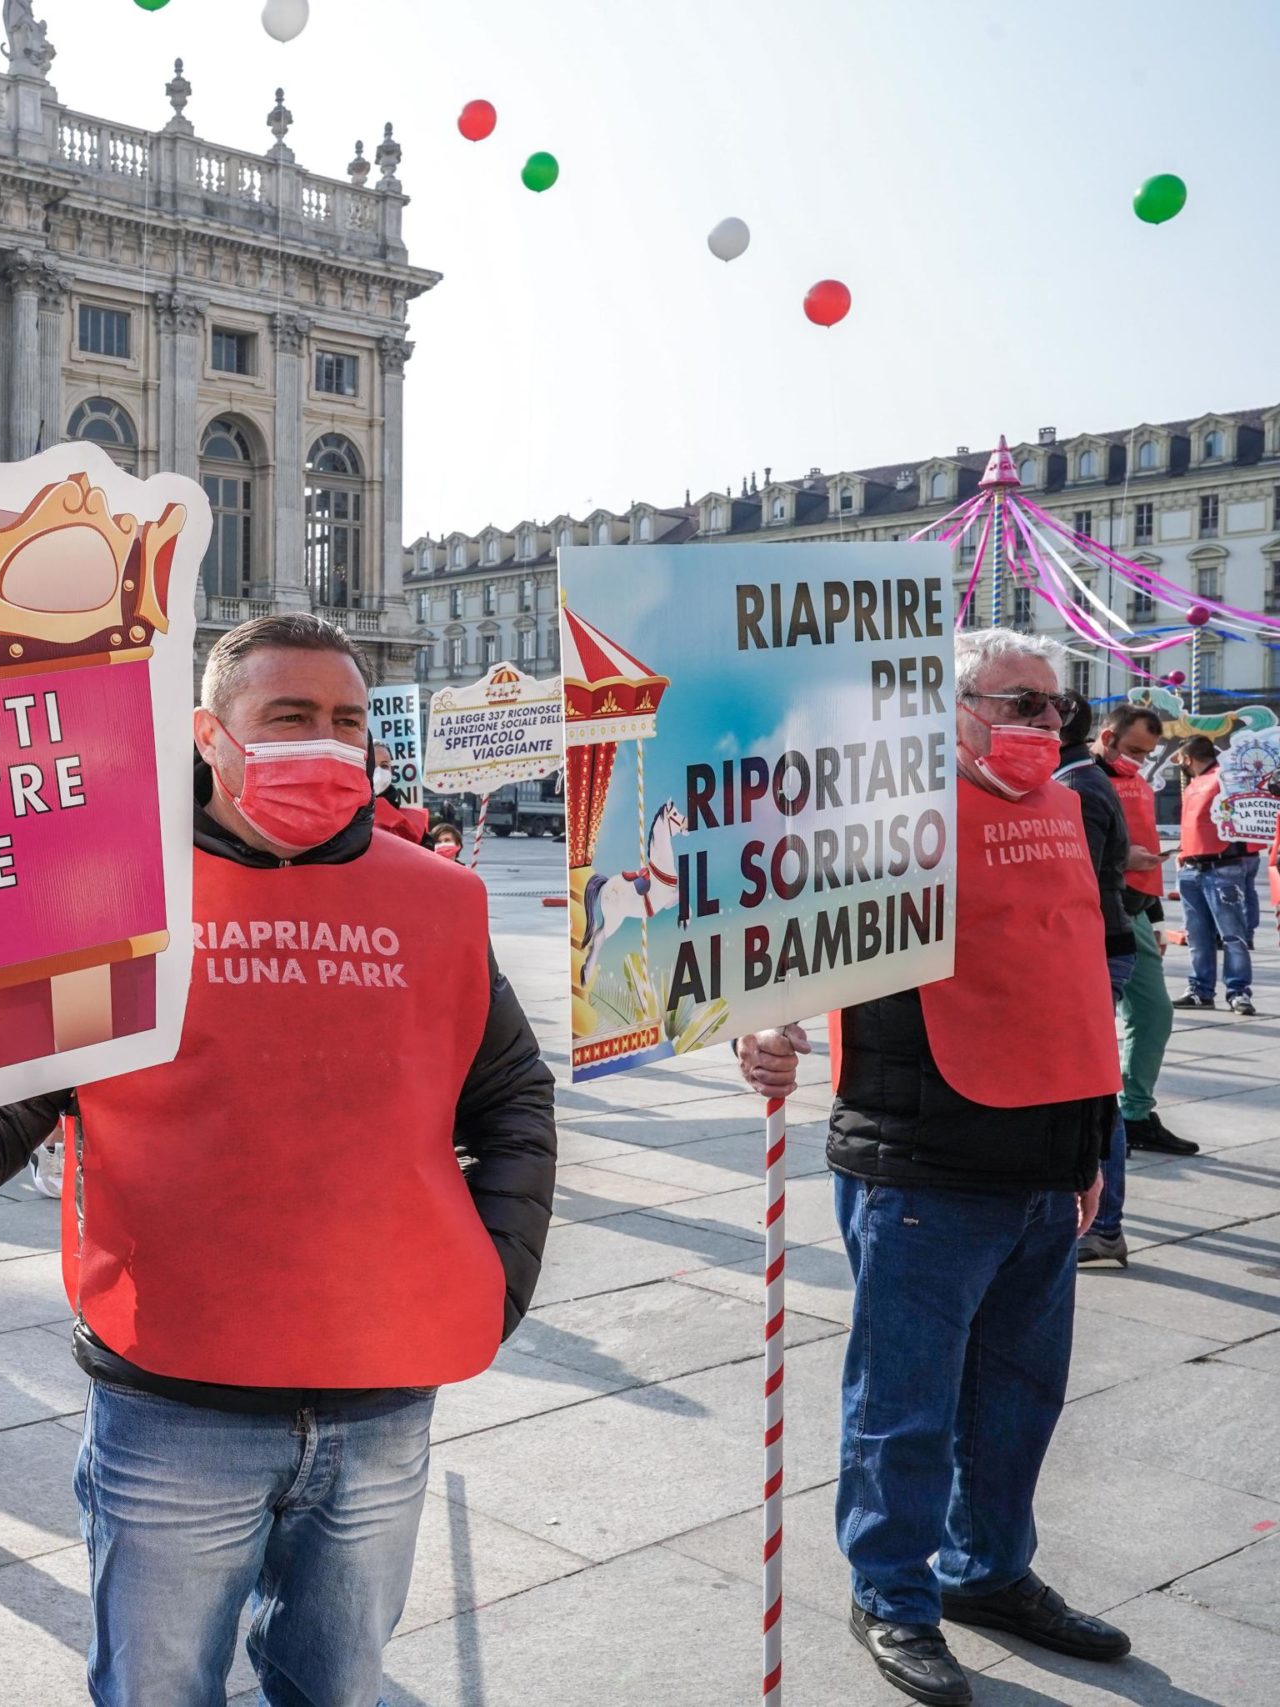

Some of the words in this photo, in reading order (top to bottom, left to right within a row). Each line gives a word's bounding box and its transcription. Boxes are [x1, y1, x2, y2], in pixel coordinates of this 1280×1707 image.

[736, 577, 943, 651] RIAPRIRE
[871, 655, 947, 721] PER
[433, 728, 446, 738] LA
[448, 721, 498, 736] FUNZIONE
[501, 716, 537, 730] SOCIALE
[540, 715, 563, 725] DELL
[440, 717, 452, 726] LA
[455, 712, 486, 725] LEGGE
[488, 710, 506, 721] 337
[508, 704, 561, 718] RICONOSCE
[381, 718, 416, 738] PER
[445, 729, 525, 750] SPETTACOLO
[473, 739, 553, 760] VIAGGIANTE
[686, 732, 946, 832] RIPORTARE
[983, 819, 1077, 843] RIAPRIAMO
[678, 850, 720, 921] IL
[739, 808, 946, 909] SORRISO
[985, 849, 993, 866] I
[999, 842, 1055, 865] LUNA
[667, 934, 721, 1012] AI
[744, 884, 945, 992] BAMBINI
[207, 958, 307, 984] LUNA
[317, 959, 409, 988] PARK
